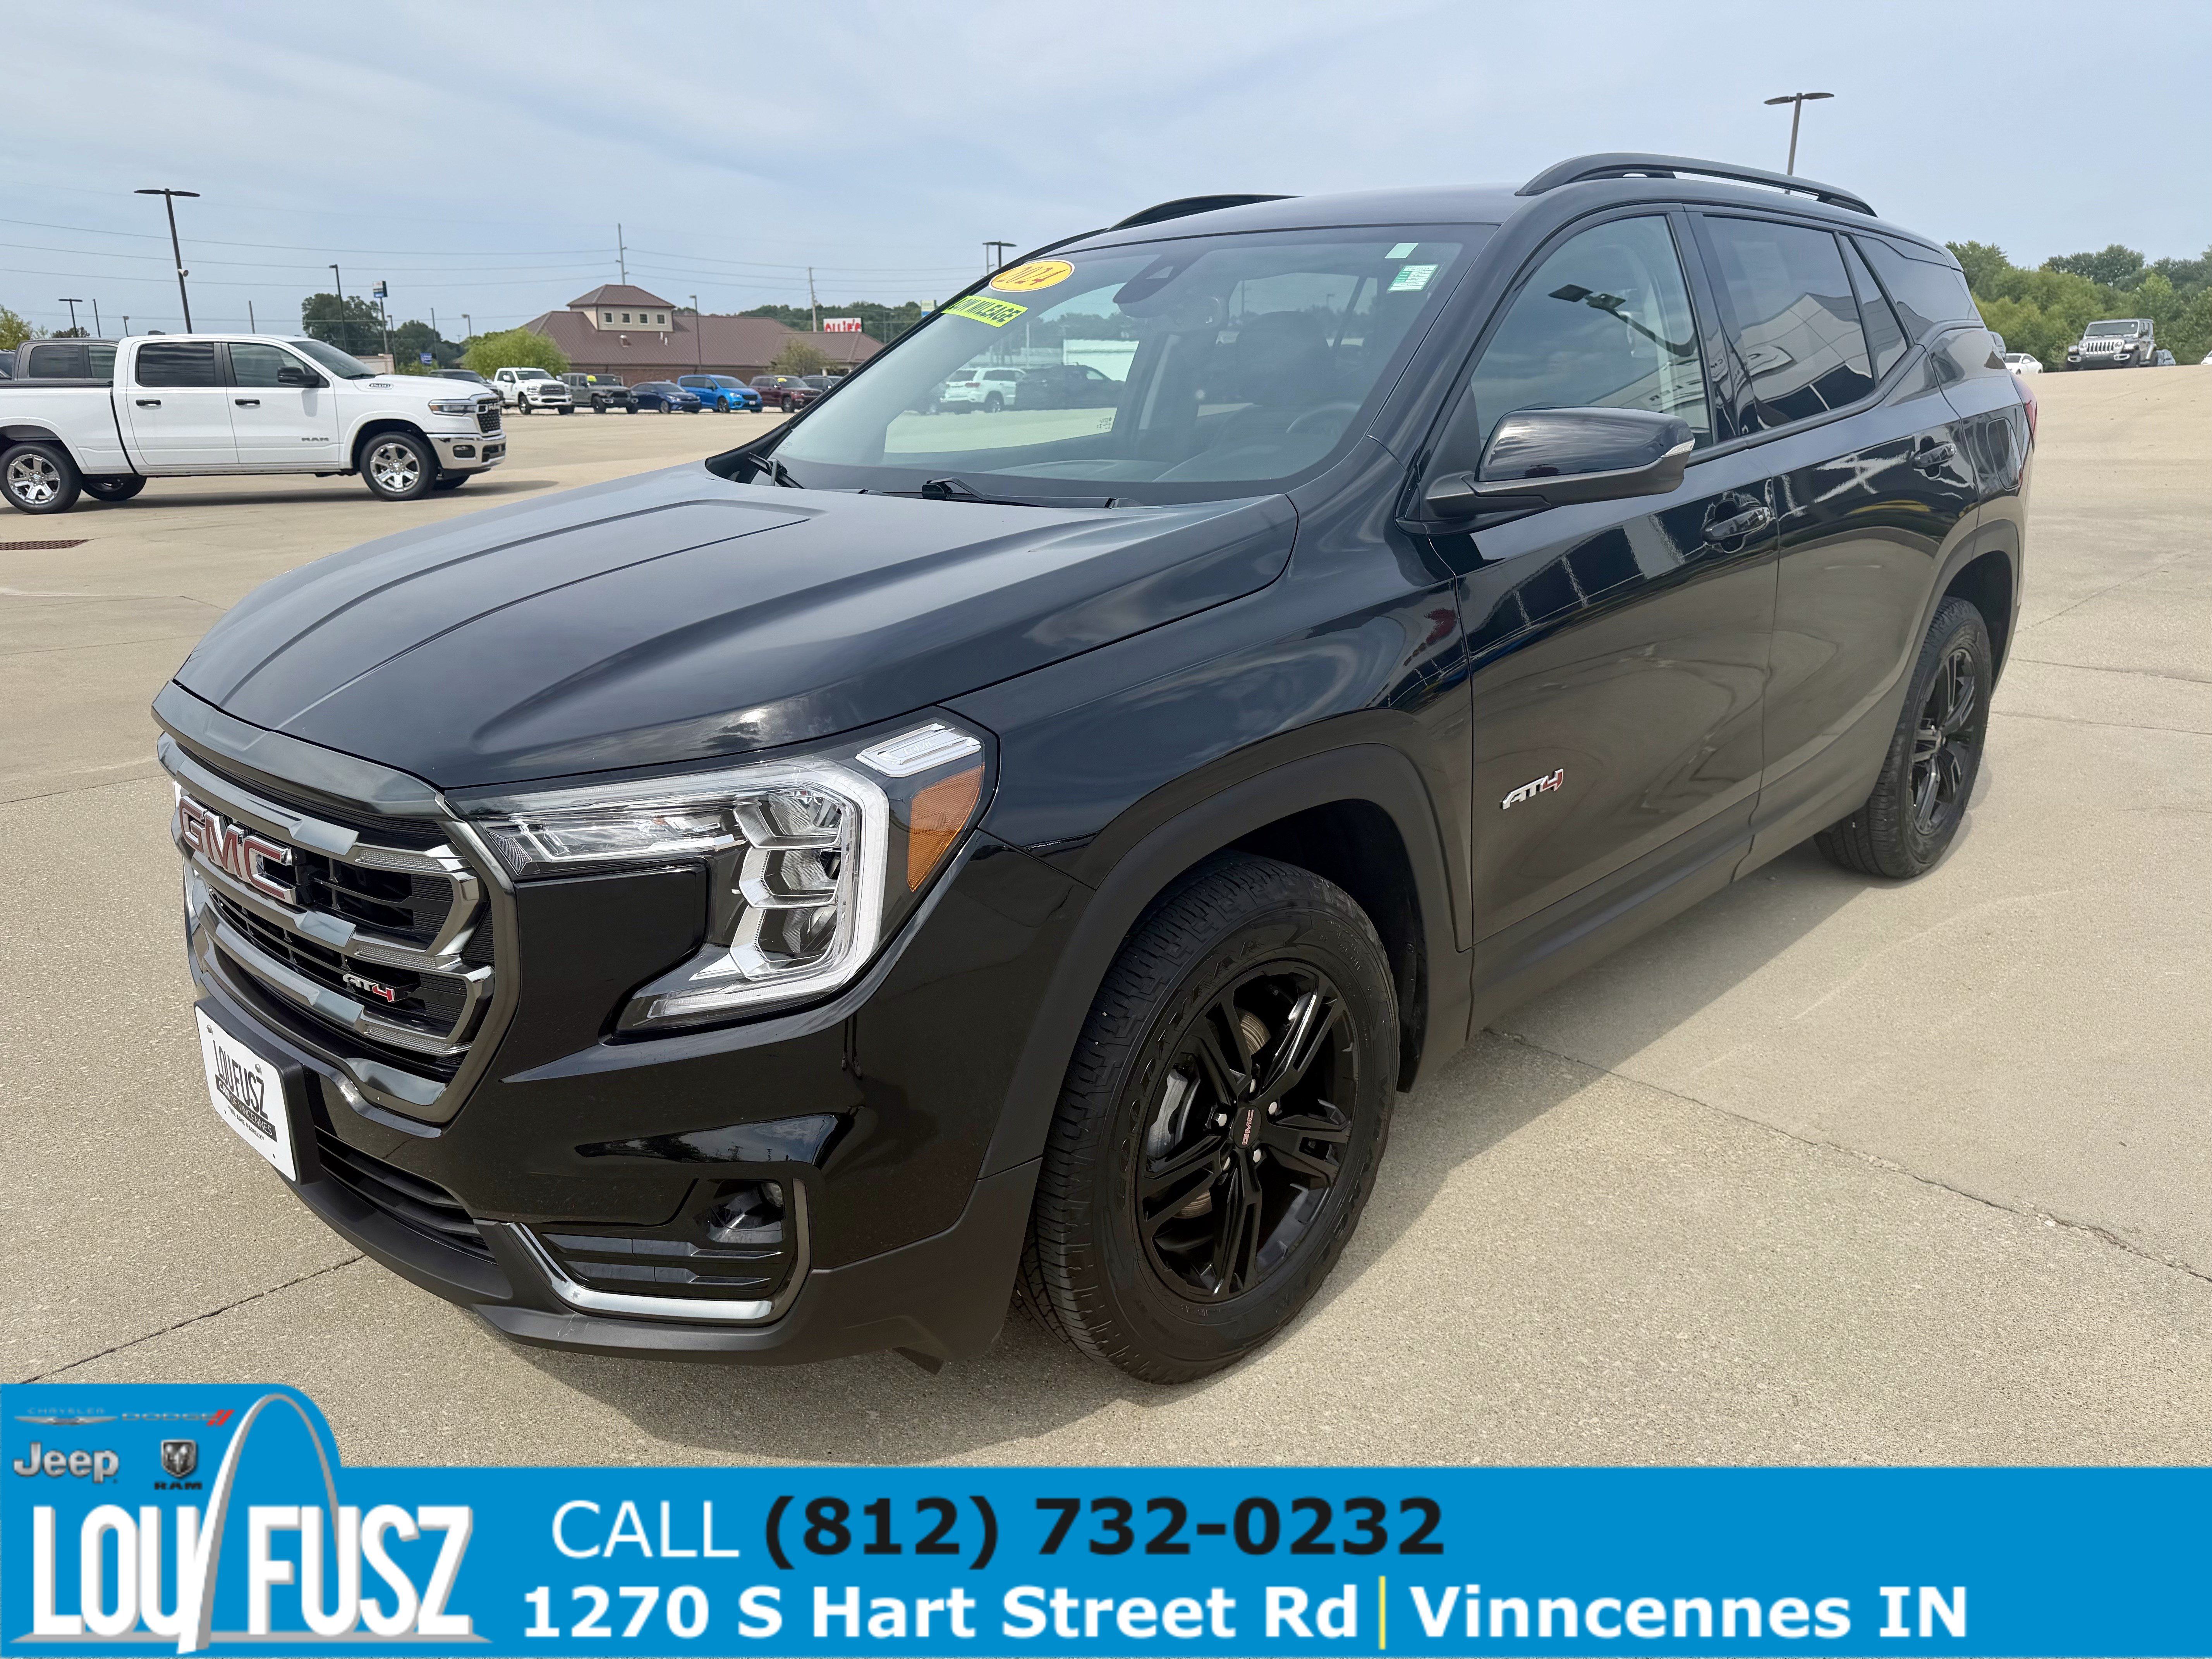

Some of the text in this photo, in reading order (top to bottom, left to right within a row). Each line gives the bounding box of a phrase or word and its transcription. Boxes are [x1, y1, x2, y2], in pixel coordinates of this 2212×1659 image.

[994, 266, 1068, 286] 2024
[948, 297, 981, 312] LOW
[964, 301, 1022, 323] MILEAGE
[1501, 768, 1563, 810] AT4
[179, 795, 297, 905] GMC
[343, 973, 396, 1002] AT4
[237, 1101, 272, 1136] VINCENNES
[1242, 1109, 1254, 1145] GMC
